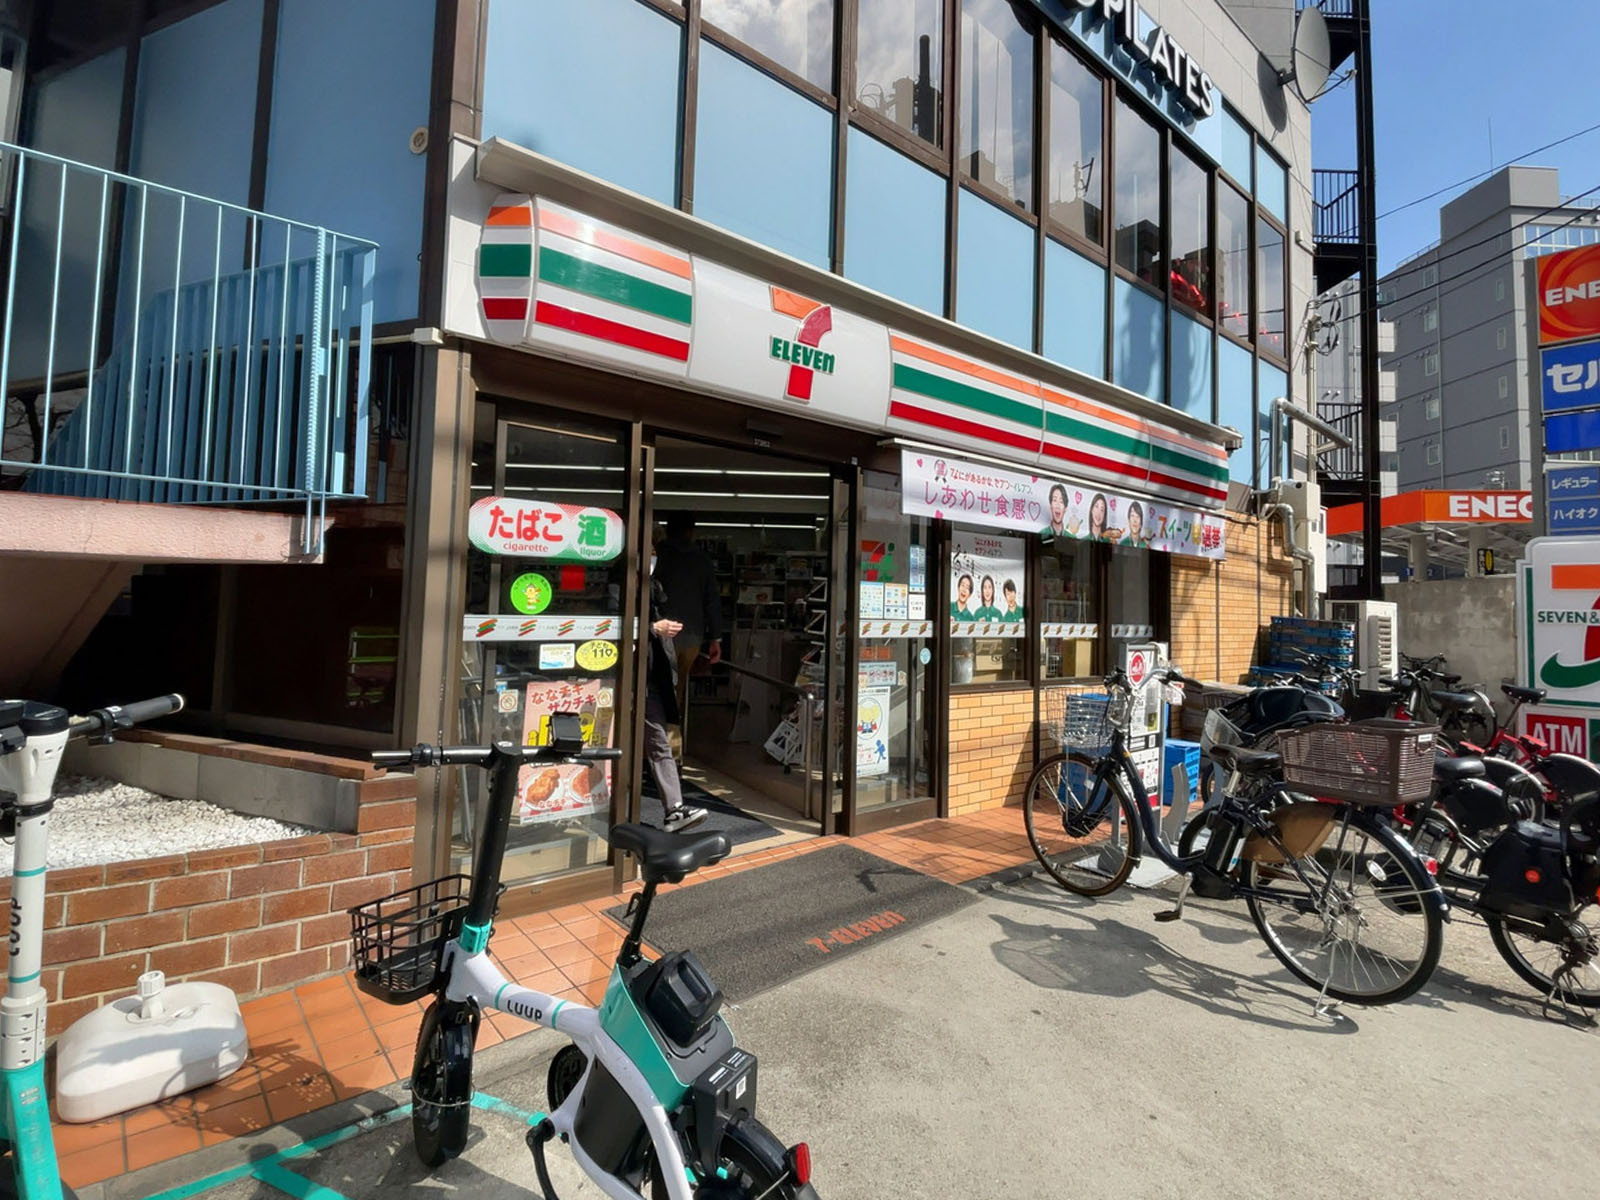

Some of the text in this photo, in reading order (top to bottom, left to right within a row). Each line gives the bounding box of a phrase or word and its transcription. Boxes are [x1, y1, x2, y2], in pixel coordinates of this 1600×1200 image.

[1551, 476, 1598, 490] レギュラー
[1553, 507, 1599, 521] ハイオク
[488, 505, 607, 547] たばこ 酒
[503, 542, 606, 557] cigarette liquor
[1533, 722, 1582, 754] ATM
[507, 999, 543, 1022] LUUP
